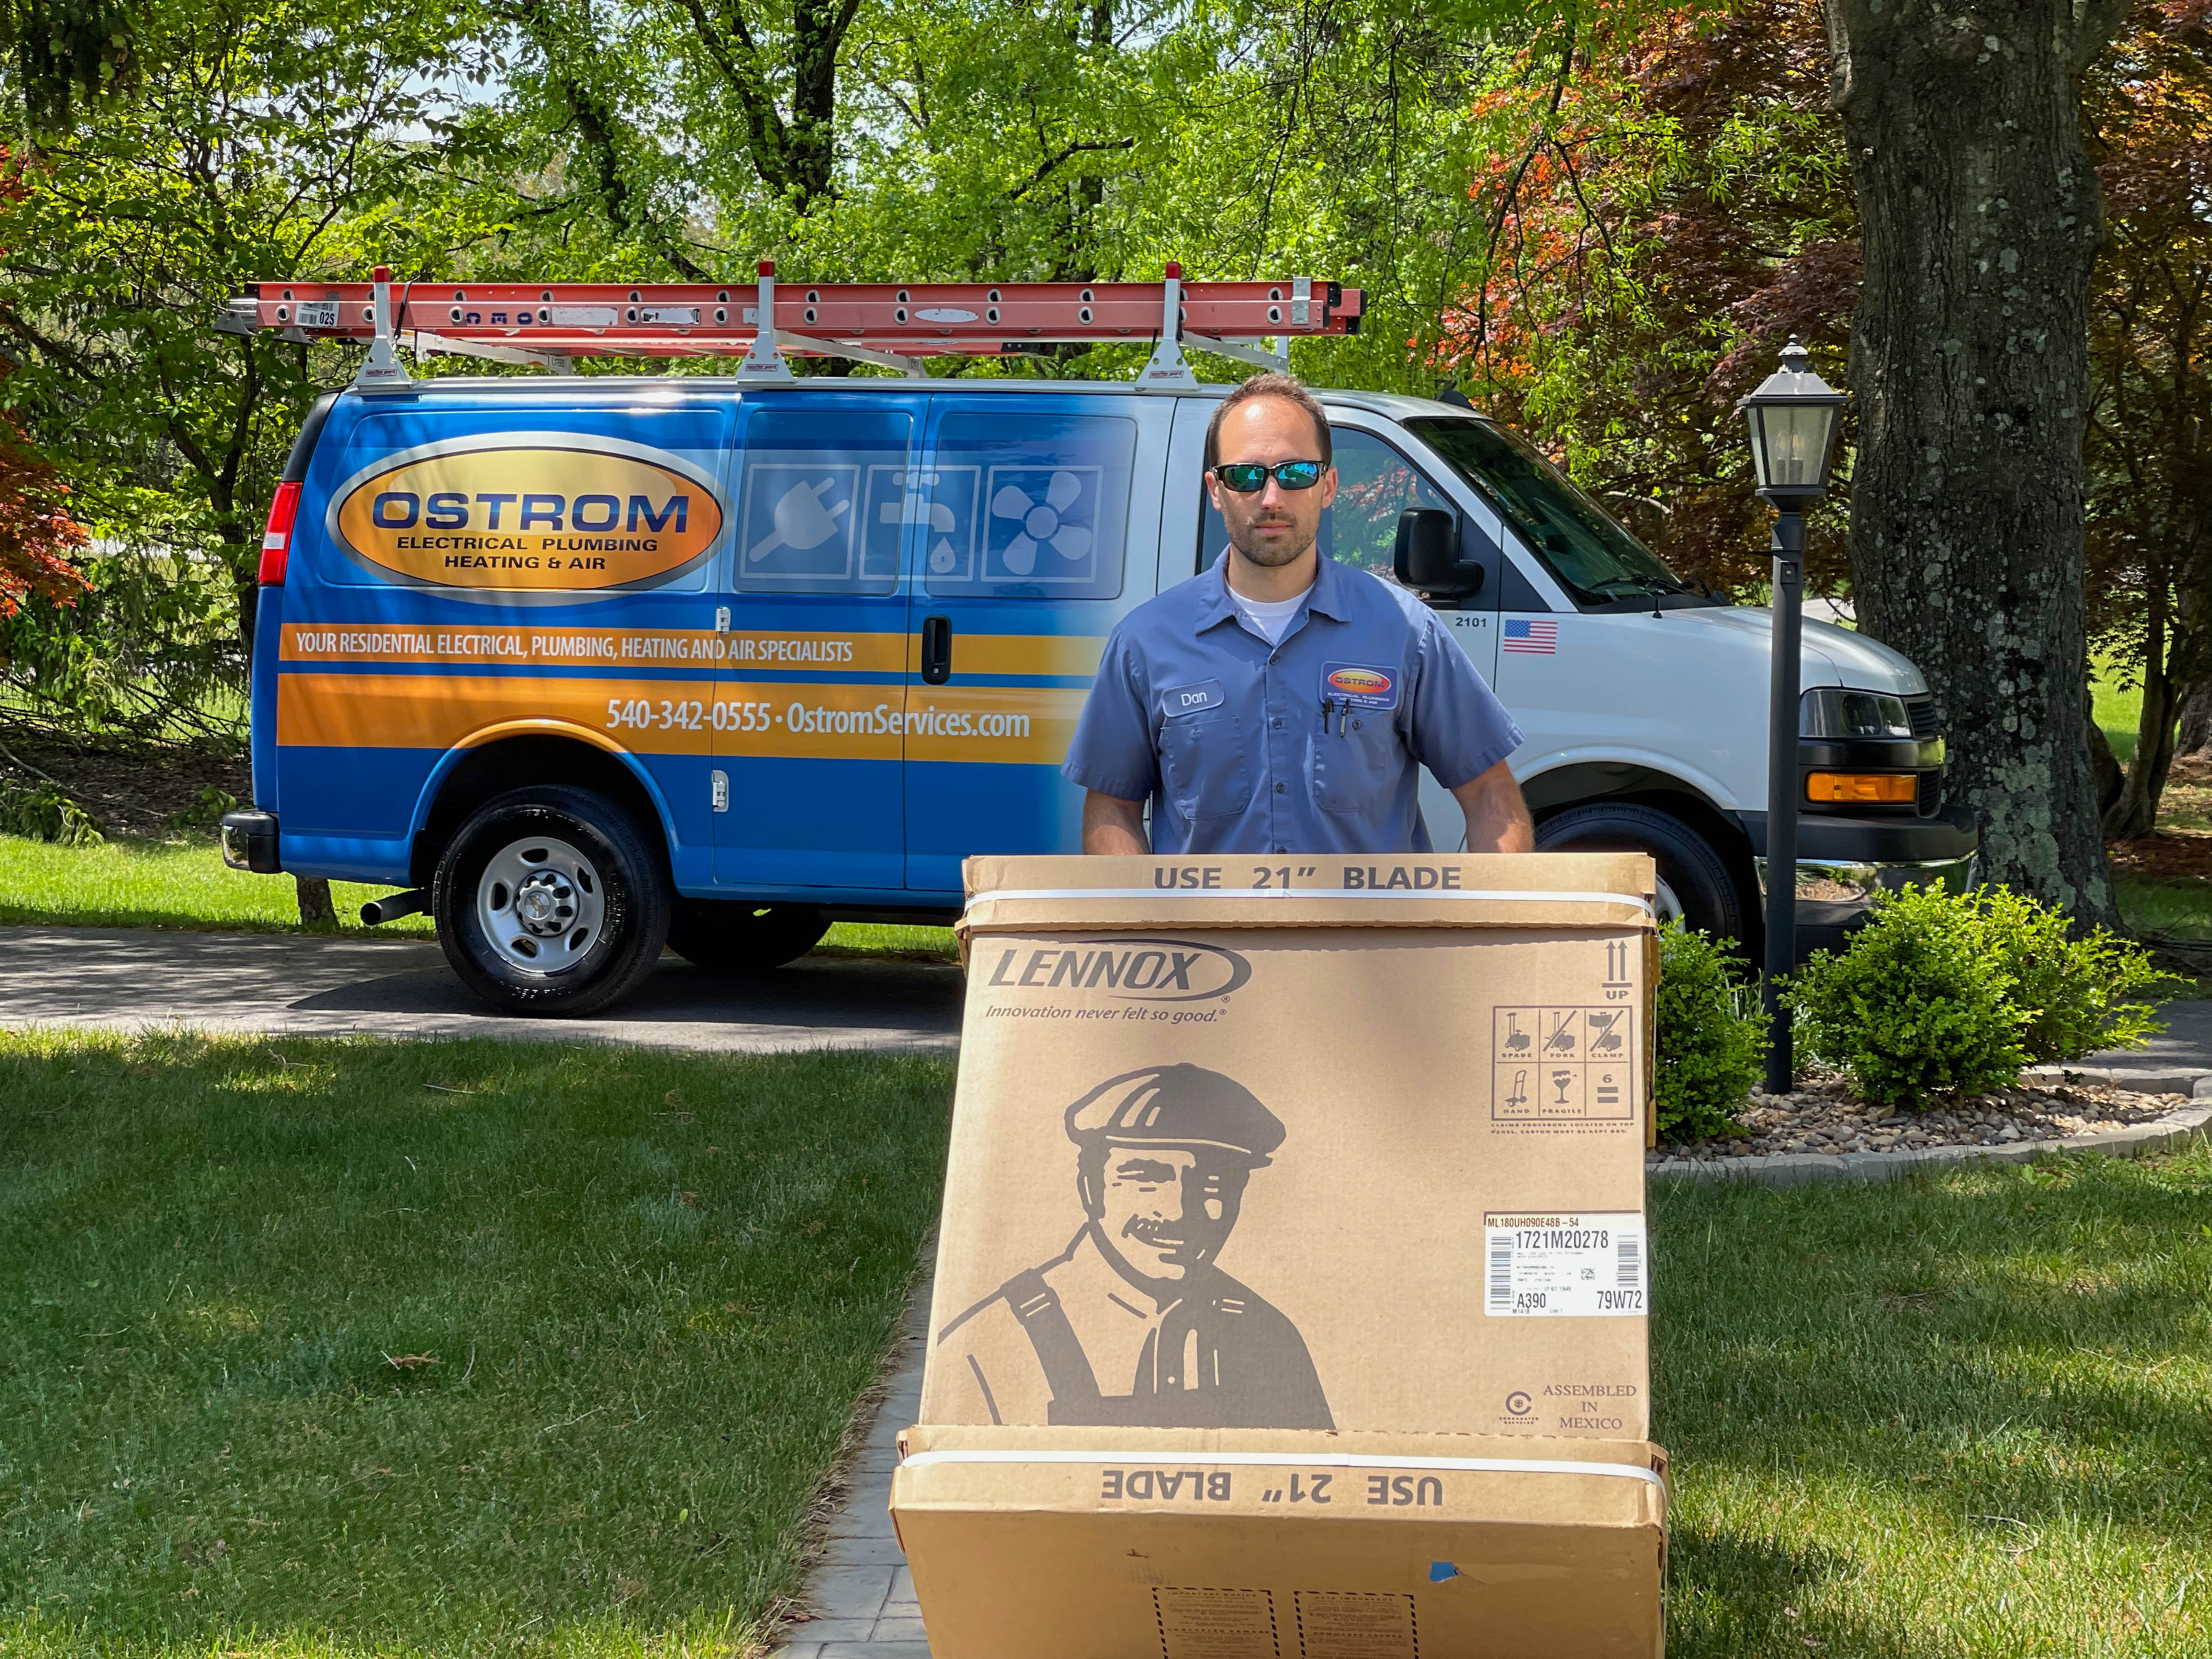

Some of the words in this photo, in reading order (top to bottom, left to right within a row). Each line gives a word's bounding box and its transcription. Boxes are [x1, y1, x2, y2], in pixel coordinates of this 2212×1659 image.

[373, 492, 689, 533] OSTROM
[397, 537, 528, 550] ELECTRICAL
[542, 538, 658, 551] PLUMBING
[445, 556, 540, 569] HEATING
[548, 557, 562, 569] &
[568, 557, 606, 569] AIR
[1455, 617, 1487, 627] 2101
[296, 633, 337, 653] YOUR
[340, 633, 434, 654] RESIDENTIAL
[437, 634, 528, 658] ELECTRICAL,
[532, 636, 618, 661] PLUMBING,
[622, 637, 688, 659] HEATING
[691, 638, 726, 659] AND
[728, 639, 756, 661] AIR
[758, 640, 853, 662] SPECIALISTS
[1335, 676, 1384, 688] OSTROM
[1181, 691, 1207, 707] Dan
[606, 699, 771, 732] 540-342-0555
[787, 703, 1030, 738] OstromServices.com
[1154, 867, 1222, 889] USE
[1344, 867, 1461, 890] BLADE
[988, 949, 1203, 990] LENNOX
[1606, 991, 1629, 1000] UP
[986, 1005, 1072, 1018] Innovation
[1075, 1008, 1119, 1019] never
[1122, 1007, 1150, 1022] felt
[1152, 1011, 1169, 1020] so
[1602, 1074, 1612, 1084] 6
[1516, 1230, 1609, 1249] 1721M20278
[1517, 1293, 1546, 1308] A390
[1597, 1290, 1642, 1309] 79W72
[1543, 1385, 1637, 1397] ASSEMBLED
[1582, 1402, 1598, 1412] IN
[1559, 1417, 1622, 1430] MEXICO
[1101, 1470, 1232, 1501] BLADE
[1367, 1476, 1443, 1506] USE
